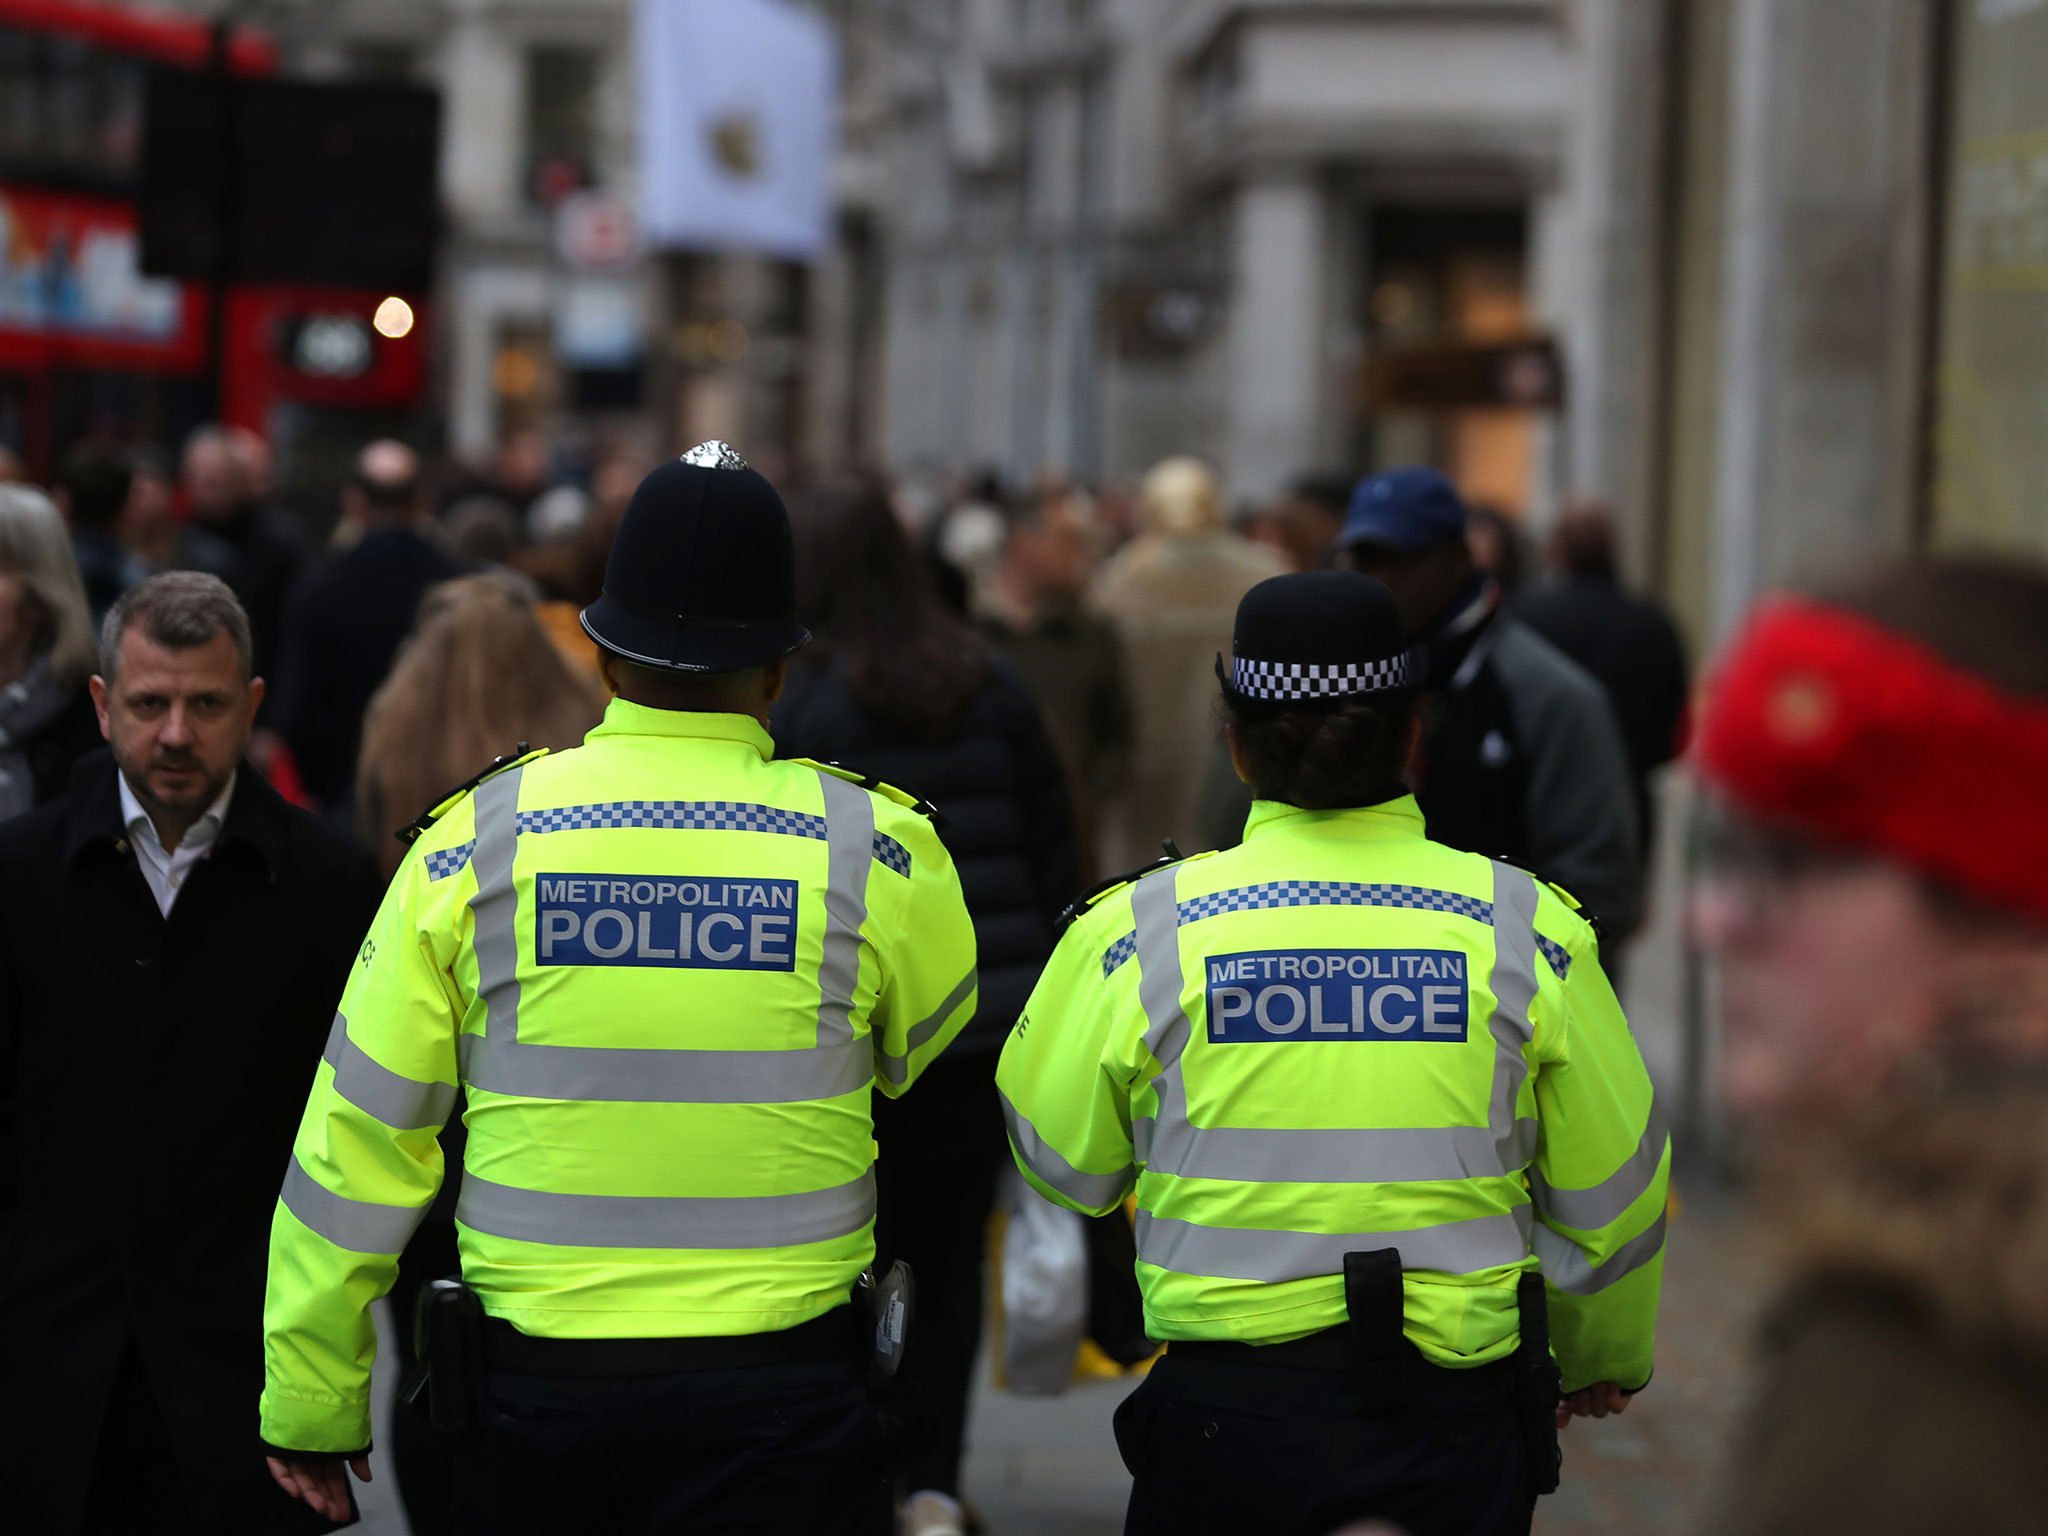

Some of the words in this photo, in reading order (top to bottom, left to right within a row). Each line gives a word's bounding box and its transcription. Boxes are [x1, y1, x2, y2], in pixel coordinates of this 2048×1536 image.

[541, 880, 793, 909] METROPOLITAN
[541, 908, 790, 963] POLICE
[1211, 955, 1463, 983] METROPOLITAN
[1211, 984, 1463, 1035] POLICE
